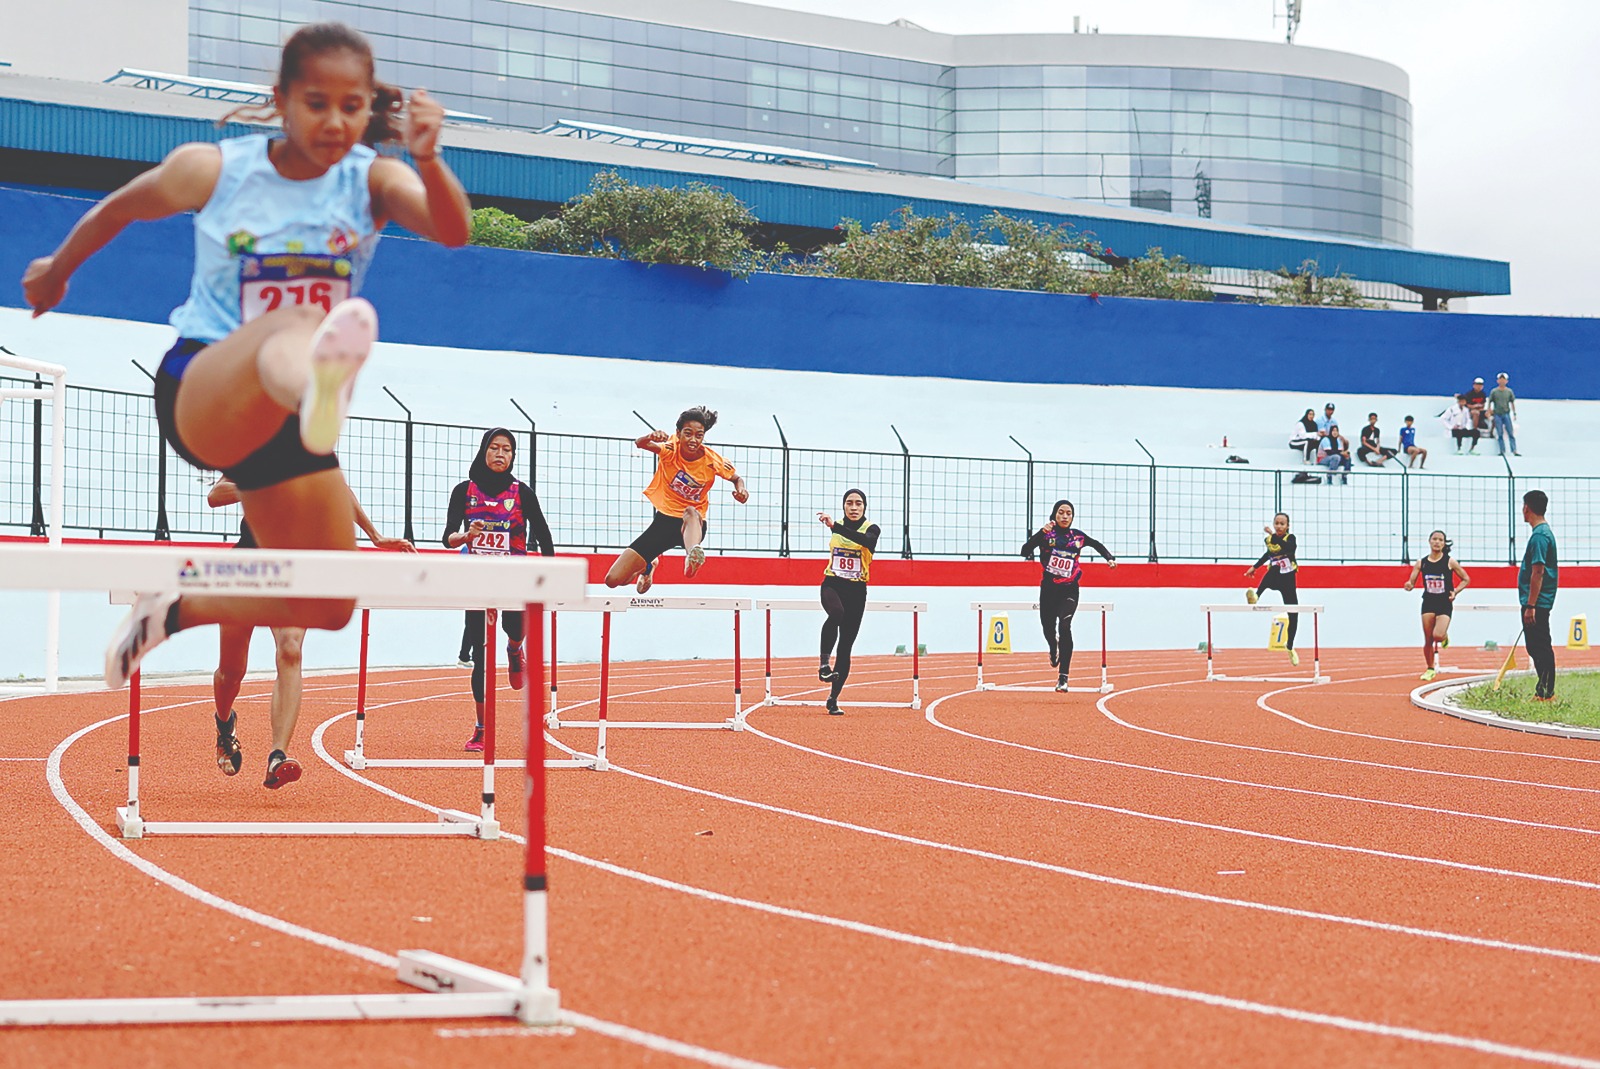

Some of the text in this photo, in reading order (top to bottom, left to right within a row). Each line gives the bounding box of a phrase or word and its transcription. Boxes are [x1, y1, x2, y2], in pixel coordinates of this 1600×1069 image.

[476, 533, 505, 549] 242
[203, 560, 281, 577] TRINITY
[839, 557, 854, 570] 89
[1051, 556, 1071, 570] 300
[1275, 621, 1285, 643] 7
[1573, 621, 1583, 642] 6
